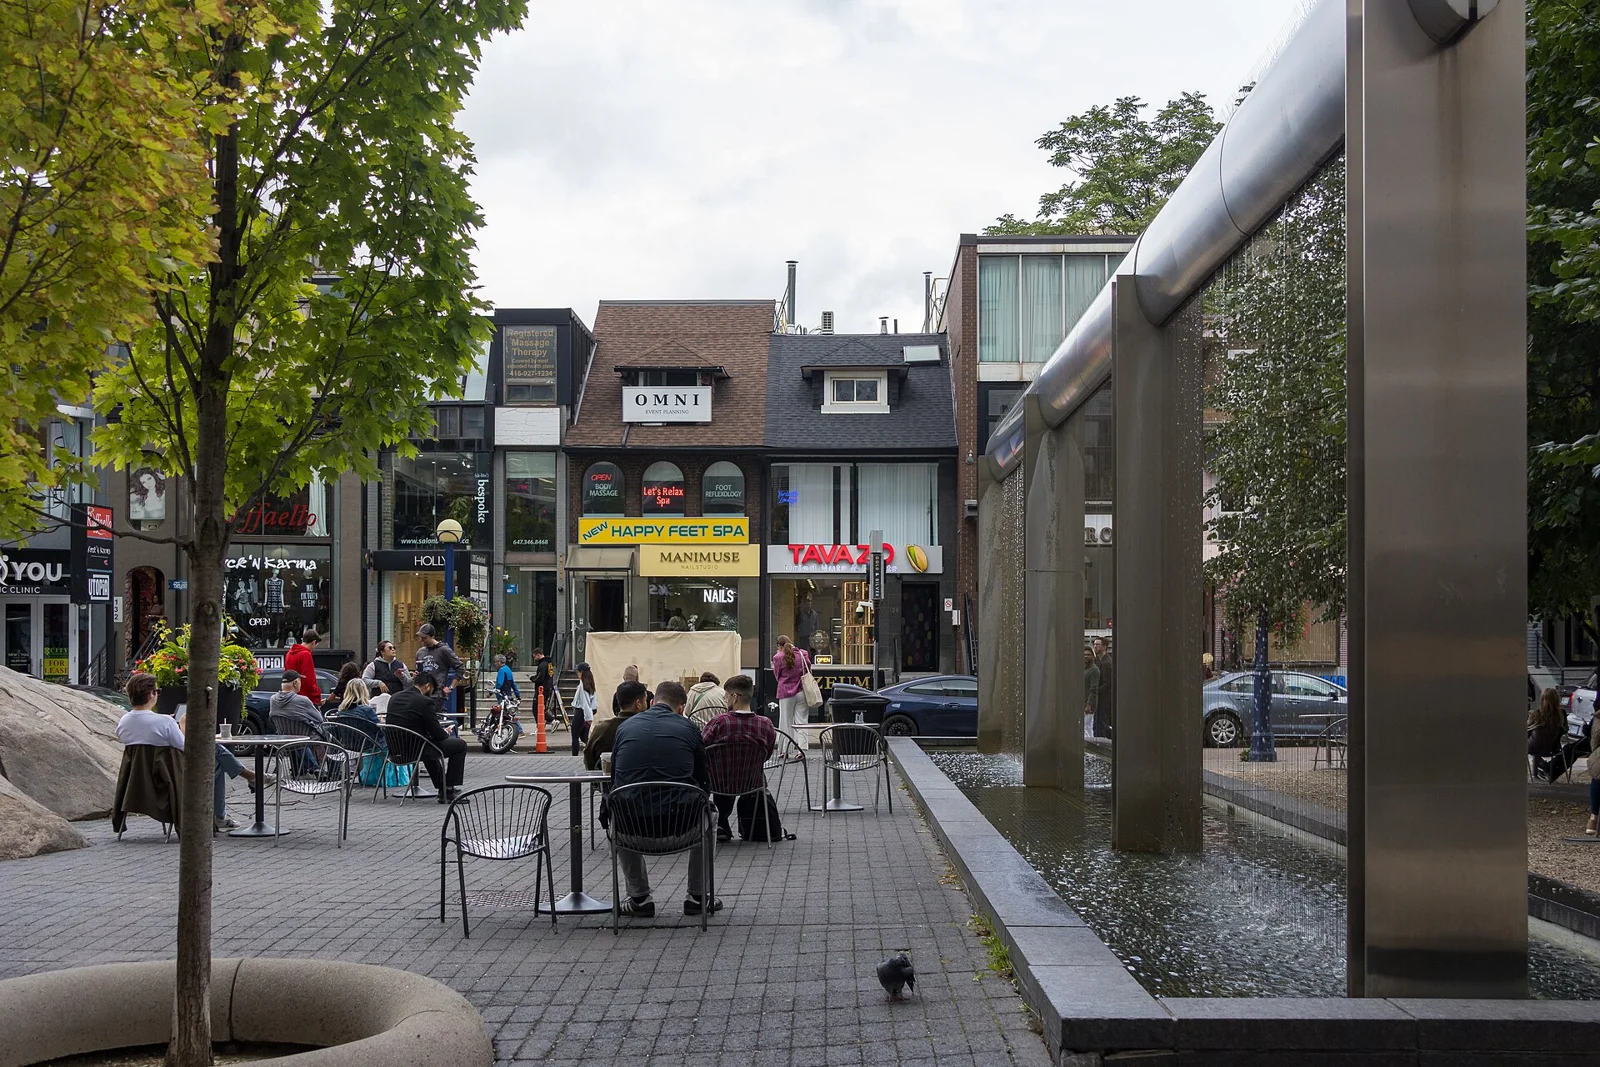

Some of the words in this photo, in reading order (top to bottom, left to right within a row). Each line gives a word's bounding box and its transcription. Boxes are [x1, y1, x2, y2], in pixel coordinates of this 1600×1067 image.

[507, 329, 554, 338] Registered
[511, 339, 550, 348] Massage
[512, 348, 548, 357] Therapy
[635, 393, 700, 406] OMNI
[591, 473, 613, 481] OPEN
[643, 486, 661, 496] Let's
[662, 486, 684, 496] Relax
[474, 479, 490, 524] bespoke
[656, 496, 671, 508] Spa
[582, 521, 609, 541] NEW
[611, 525, 665, 537] HAPPY
[668, 525, 709, 537] FEET
[712, 525, 745, 537] SPA
[660, 551, 740, 564] MANIMUSE
[263, 557, 318, 571] Karma
[850, 564, 859, 572] &
[10, 561, 63, 582] YOU
[9, 586, 41, 594] CLINIC
[703, 589, 735, 603] NAILS
[249, 617, 271, 626] OPEN
[48, 659, 65, 667] FOR
